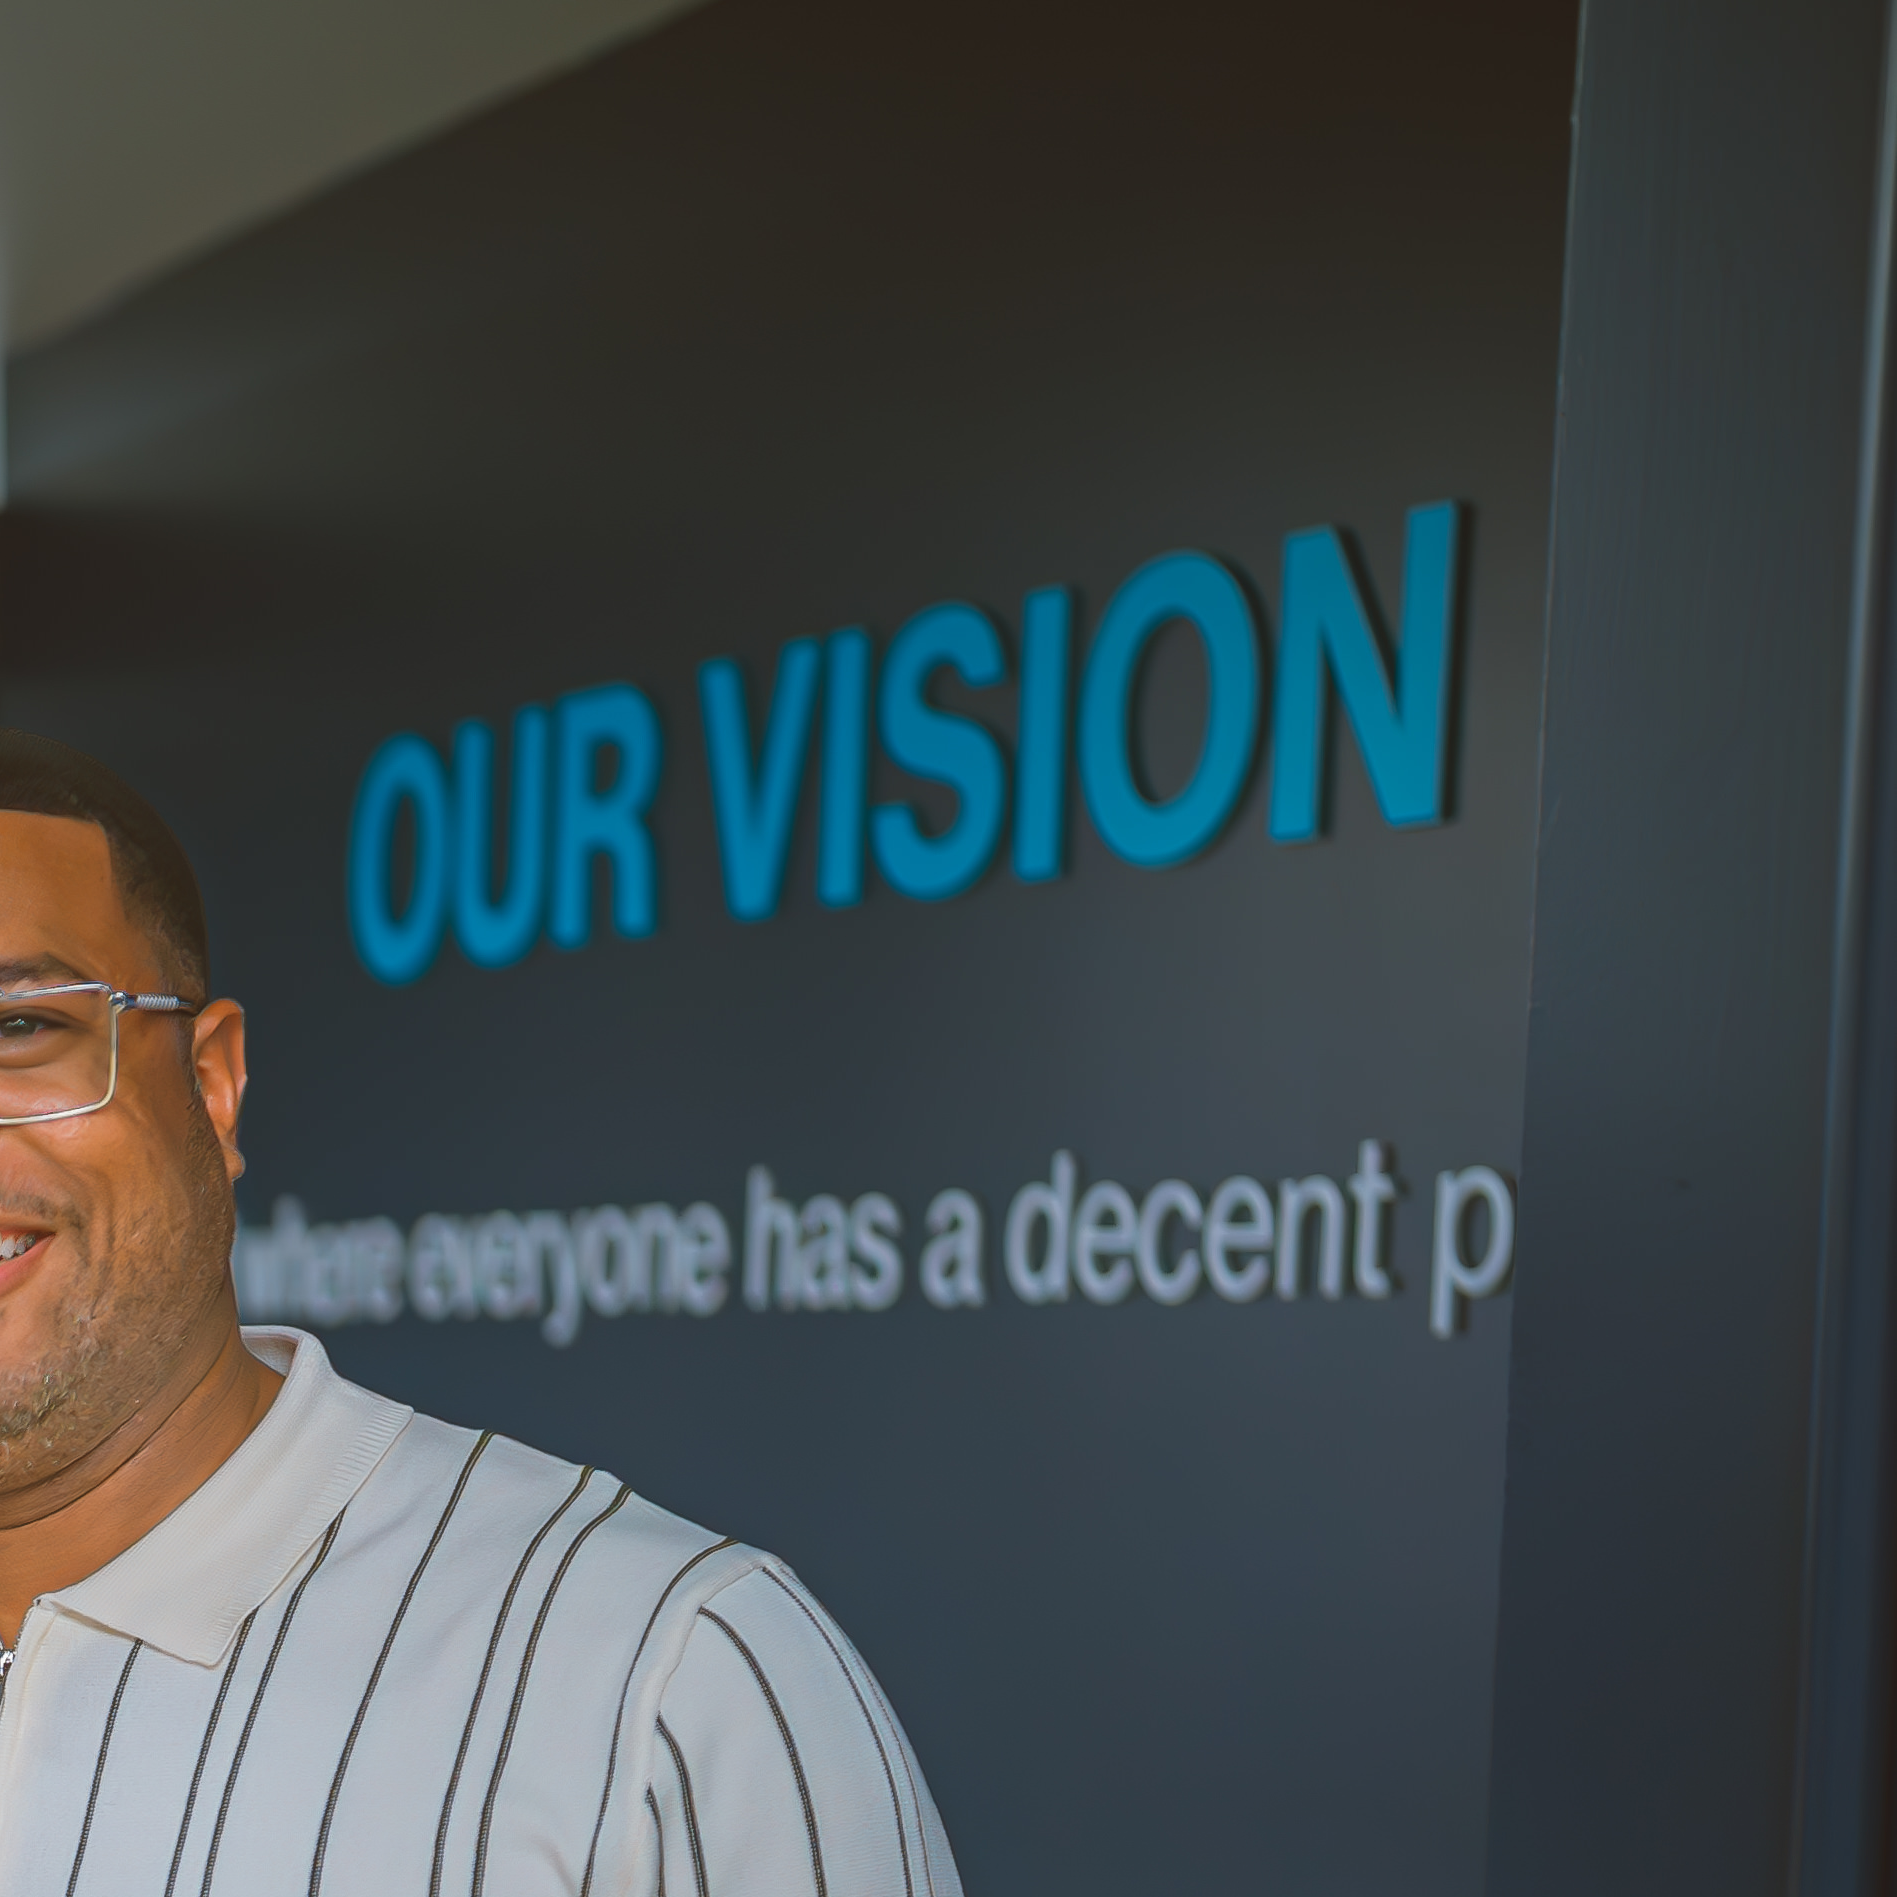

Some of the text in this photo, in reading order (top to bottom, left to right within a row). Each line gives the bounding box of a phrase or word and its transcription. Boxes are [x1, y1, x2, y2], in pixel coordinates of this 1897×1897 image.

[348, 500, 1462, 987] OUR VISION
[408, 1200, 733, 1348] everyone
[743, 1164, 906, 1314] has
[919, 1188, 987, 1311] a
[1004, 1136, 1400, 1309] decent
